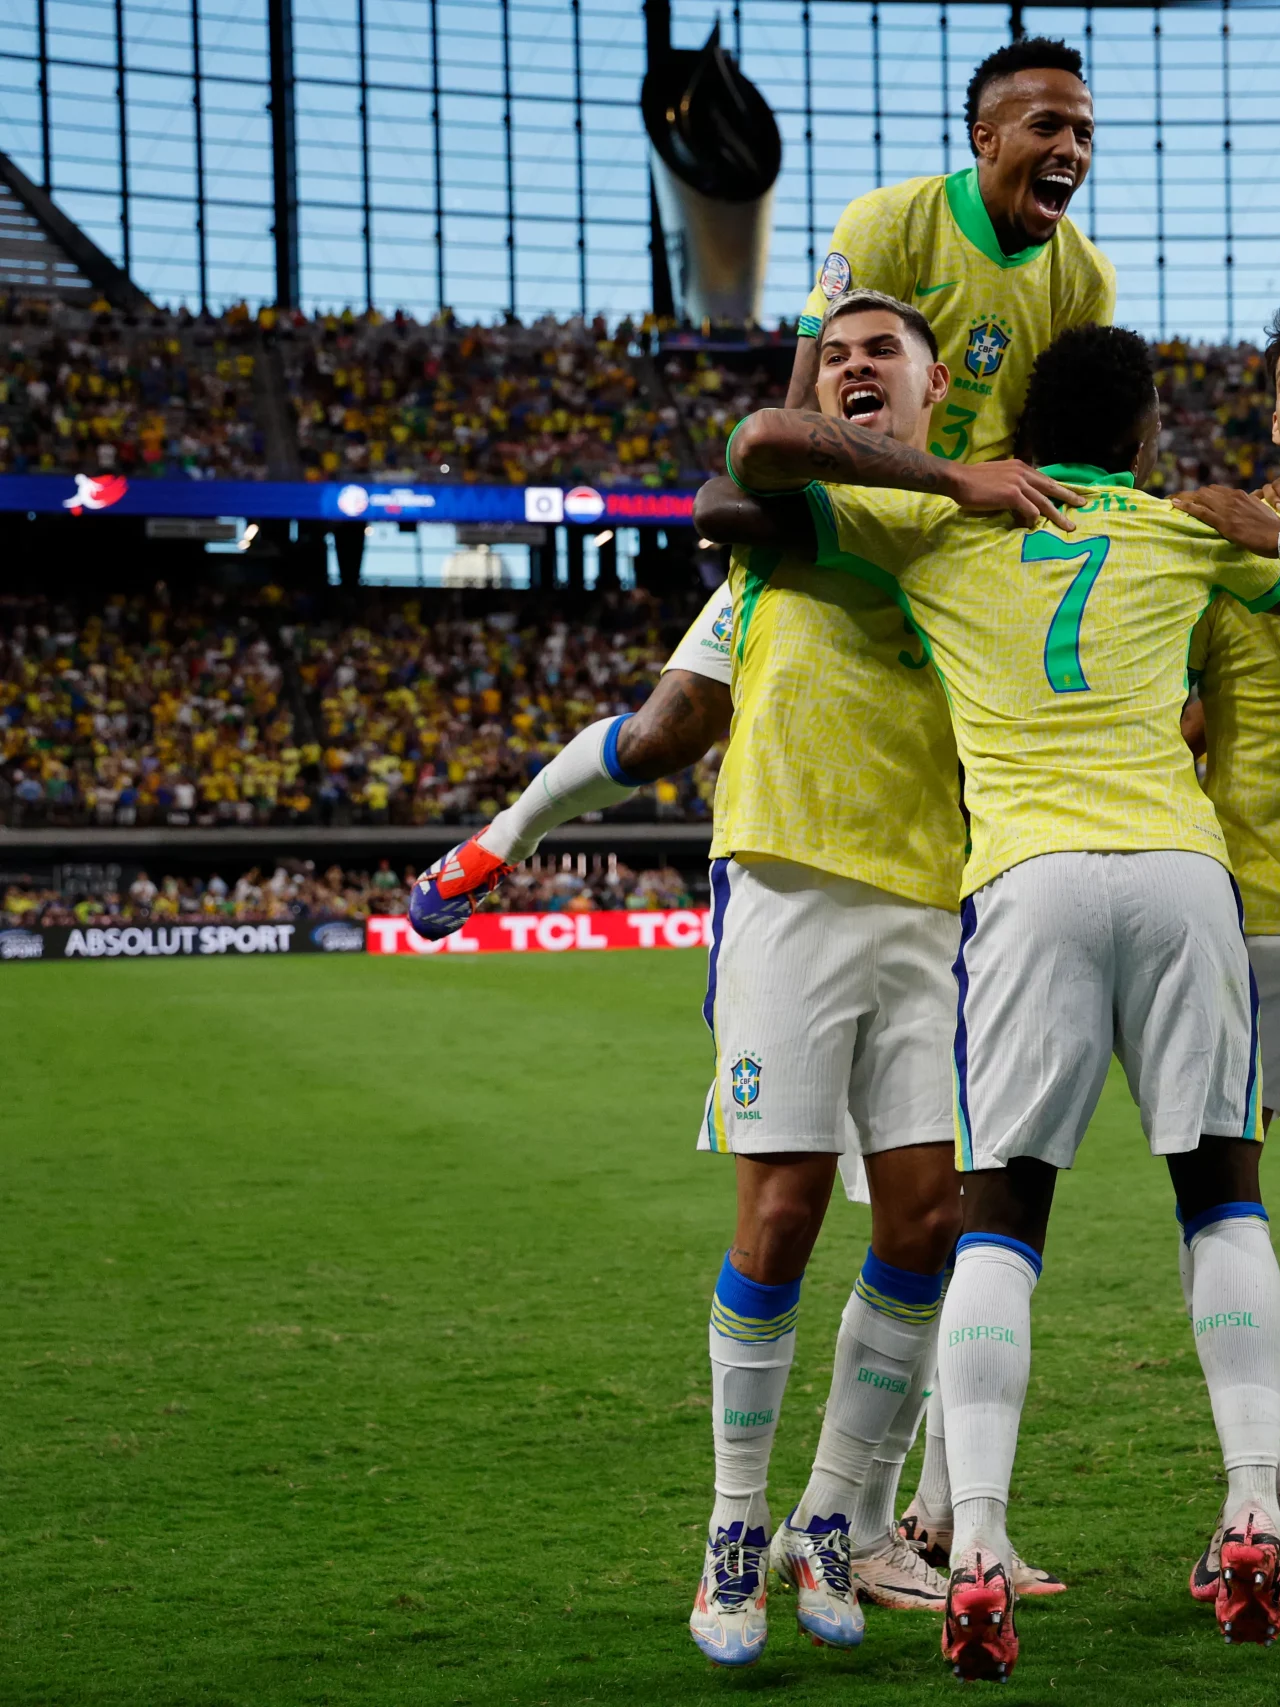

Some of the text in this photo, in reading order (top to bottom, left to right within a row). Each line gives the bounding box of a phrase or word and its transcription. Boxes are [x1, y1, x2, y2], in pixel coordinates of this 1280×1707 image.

[978, 344, 993, 354] CBF
[953, 377, 993, 396] BRASIL
[930, 403, 977, 460] 3
[1021, 530, 1111, 693] 7
[700, 638, 730, 656] BRASI
[65, 926, 199, 957] ABSOLUT
[199, 925, 295, 954] SPORT
[499, 913, 608, 952] TCL
[949, 1325, 1020, 1348] BRASIL
[1195, 1311, 1260, 1338] BRASIL
[858, 1367, 909, 1395] BRASIL
[723, 1408, 775, 1427] BRASIL
